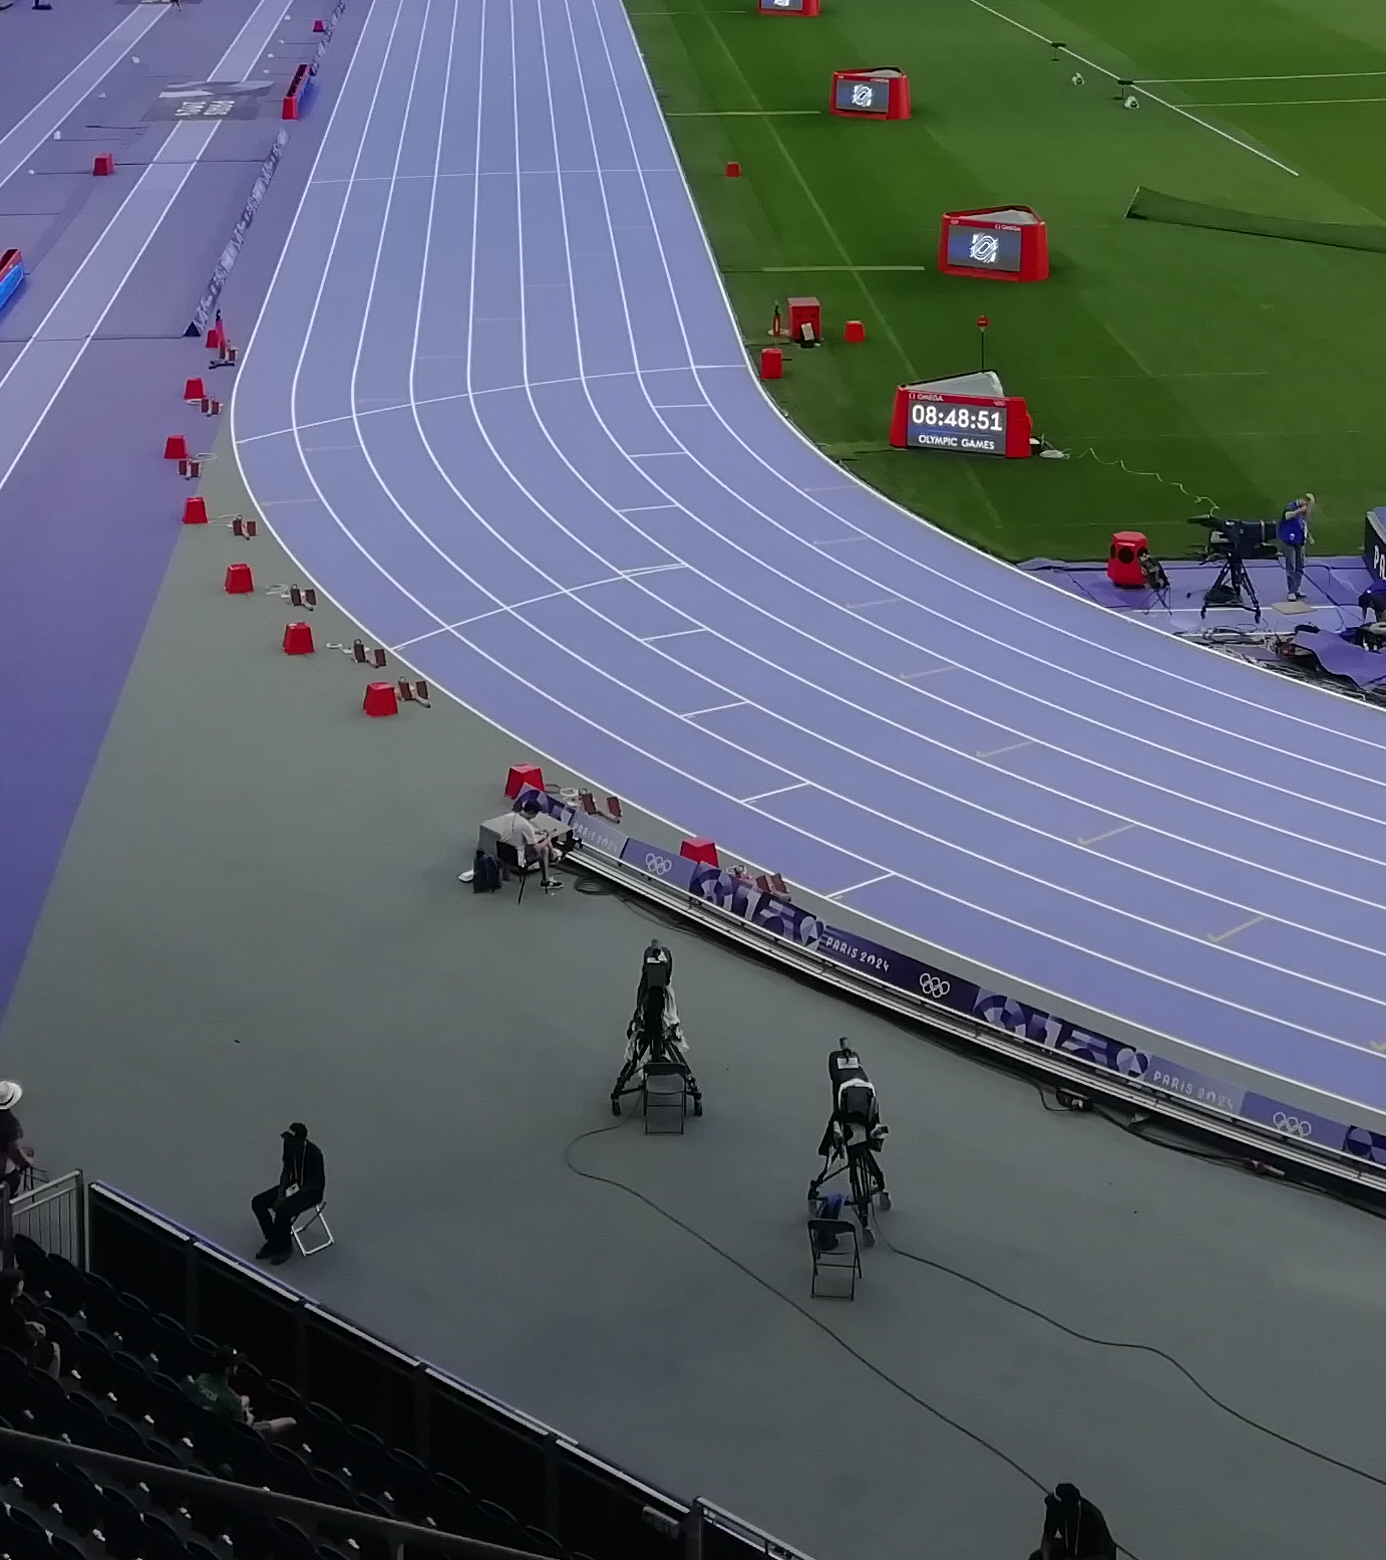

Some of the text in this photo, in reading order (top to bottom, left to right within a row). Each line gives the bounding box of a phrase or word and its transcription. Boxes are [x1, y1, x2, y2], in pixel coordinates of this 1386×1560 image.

[917, 393, 944, 402] OMEGA
[912, 405, 1003, 431] 08:48:51
[918, 435, 995, 450] OLYMPIC GAMES
[573, 822, 596, 842] PARIS
[826, 936, 890, 973] PARIS 2024
[1153, 1070, 1235, 1111] PARIS 2024
